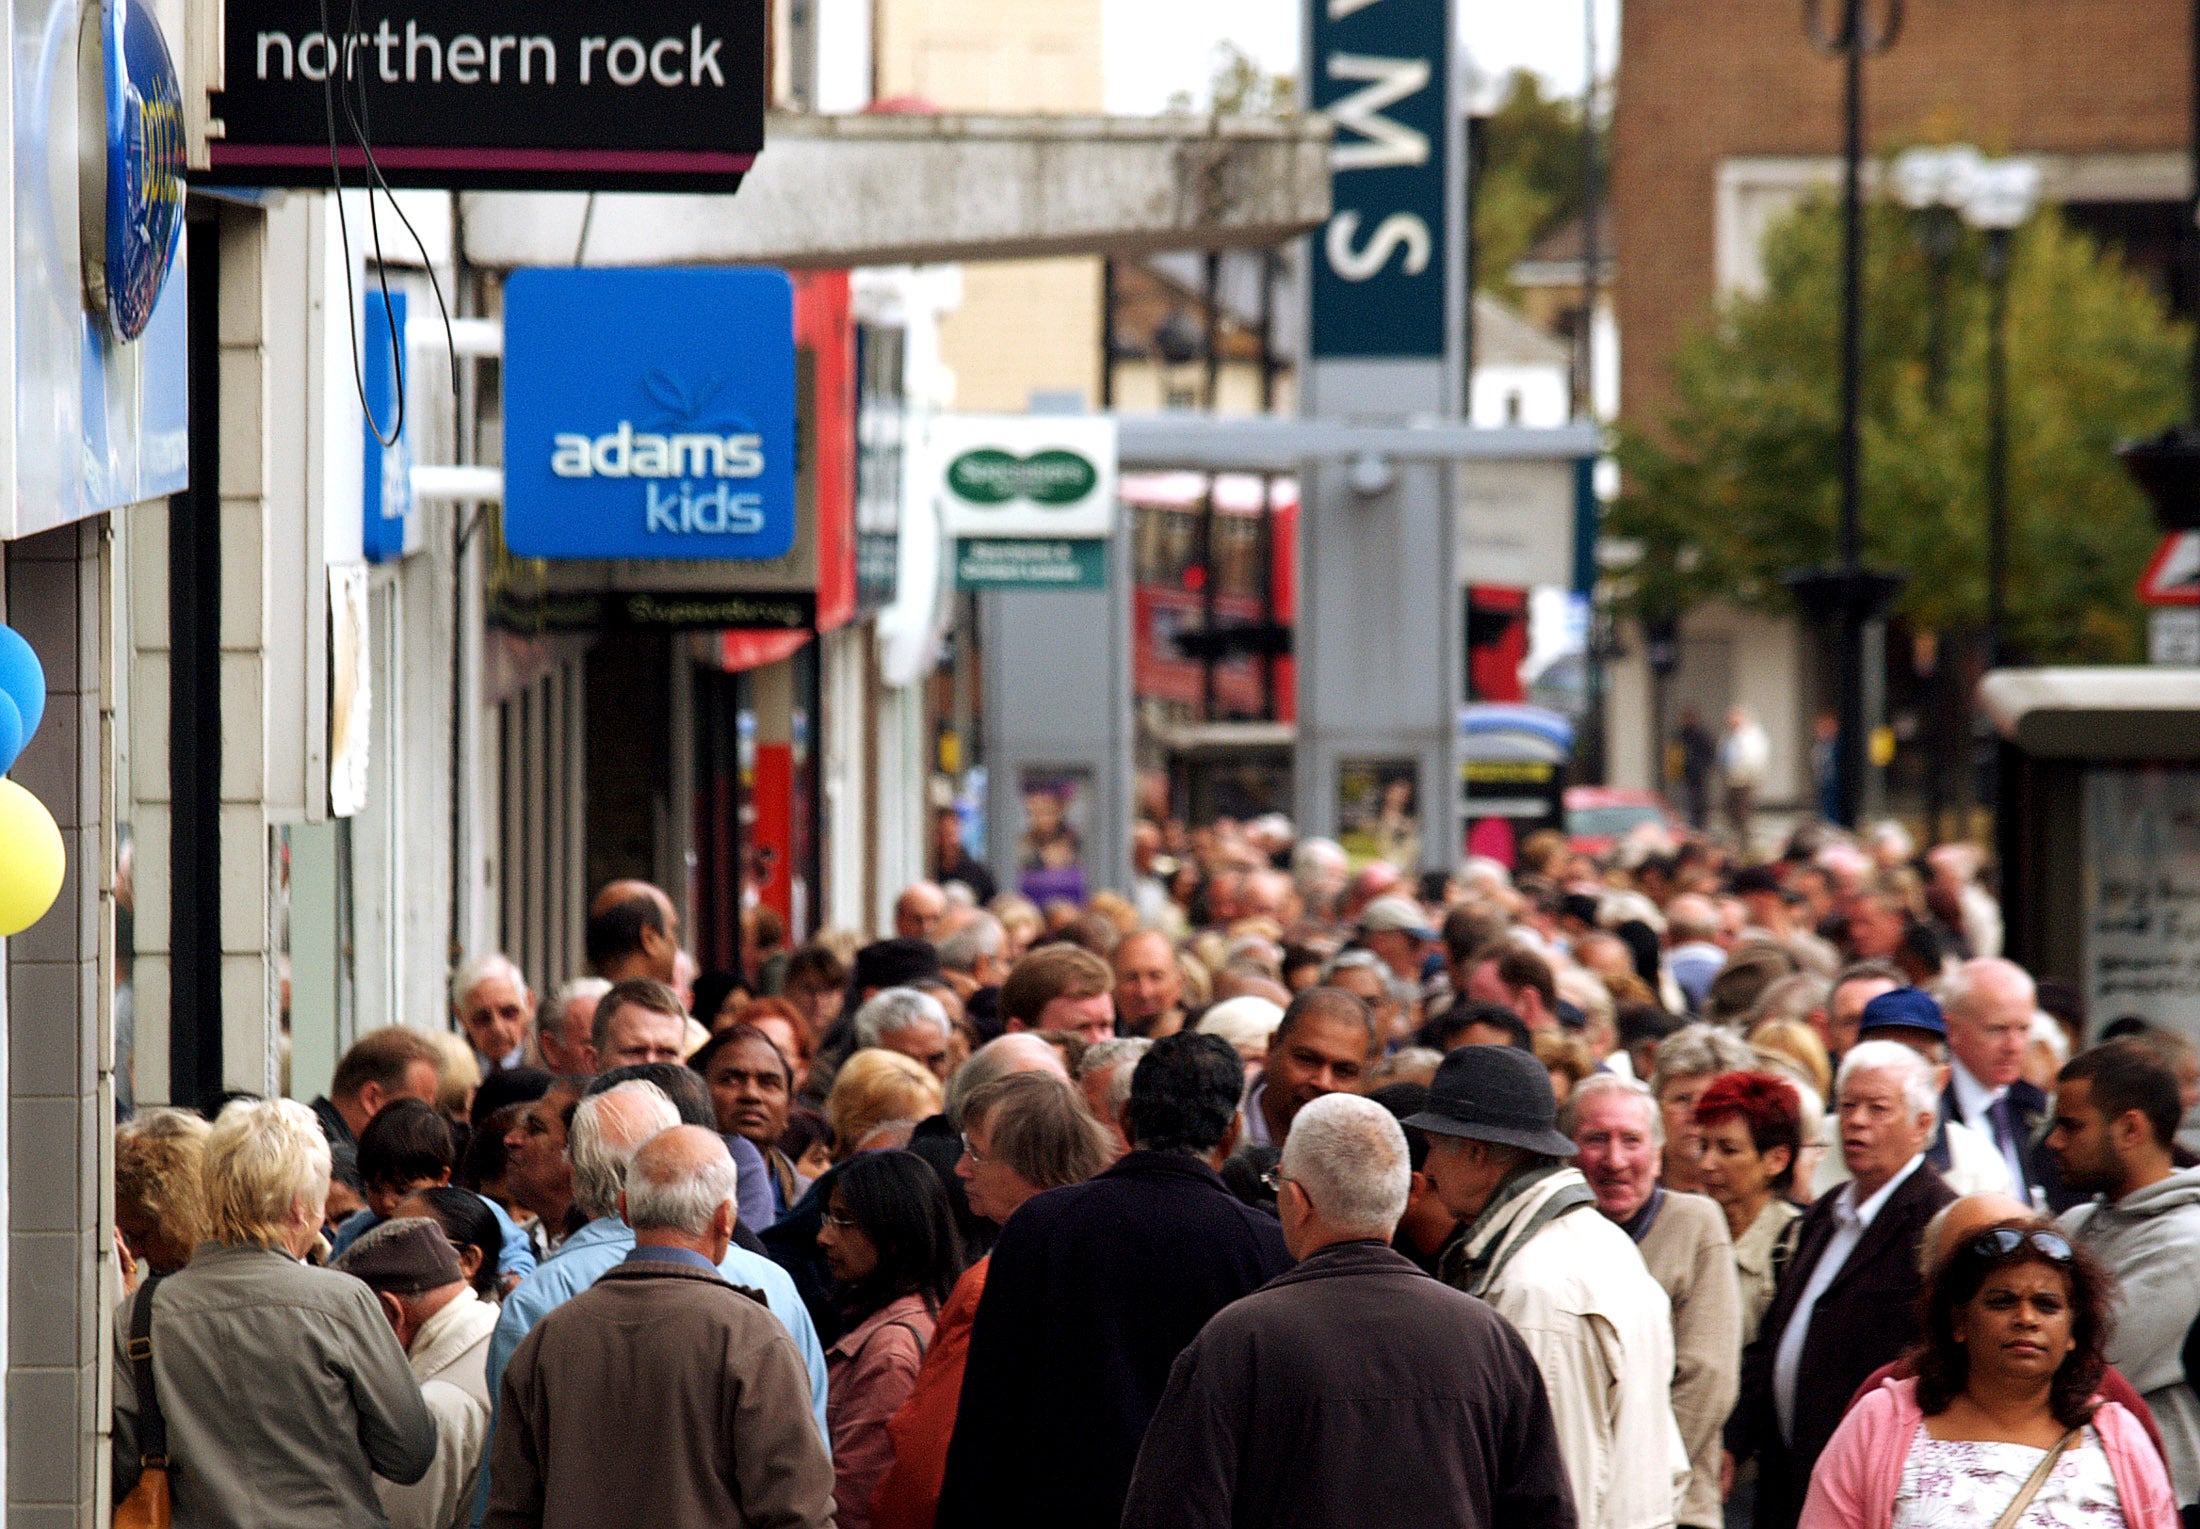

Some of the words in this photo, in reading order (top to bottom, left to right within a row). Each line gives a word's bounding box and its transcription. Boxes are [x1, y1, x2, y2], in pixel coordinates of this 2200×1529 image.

[256, 19, 557, 84] northern
[580, 24, 725, 87] rock
[1326, 0, 1432, 282] MS
[551, 419, 765, 478] adams
[646, 480, 765, 534] kids
